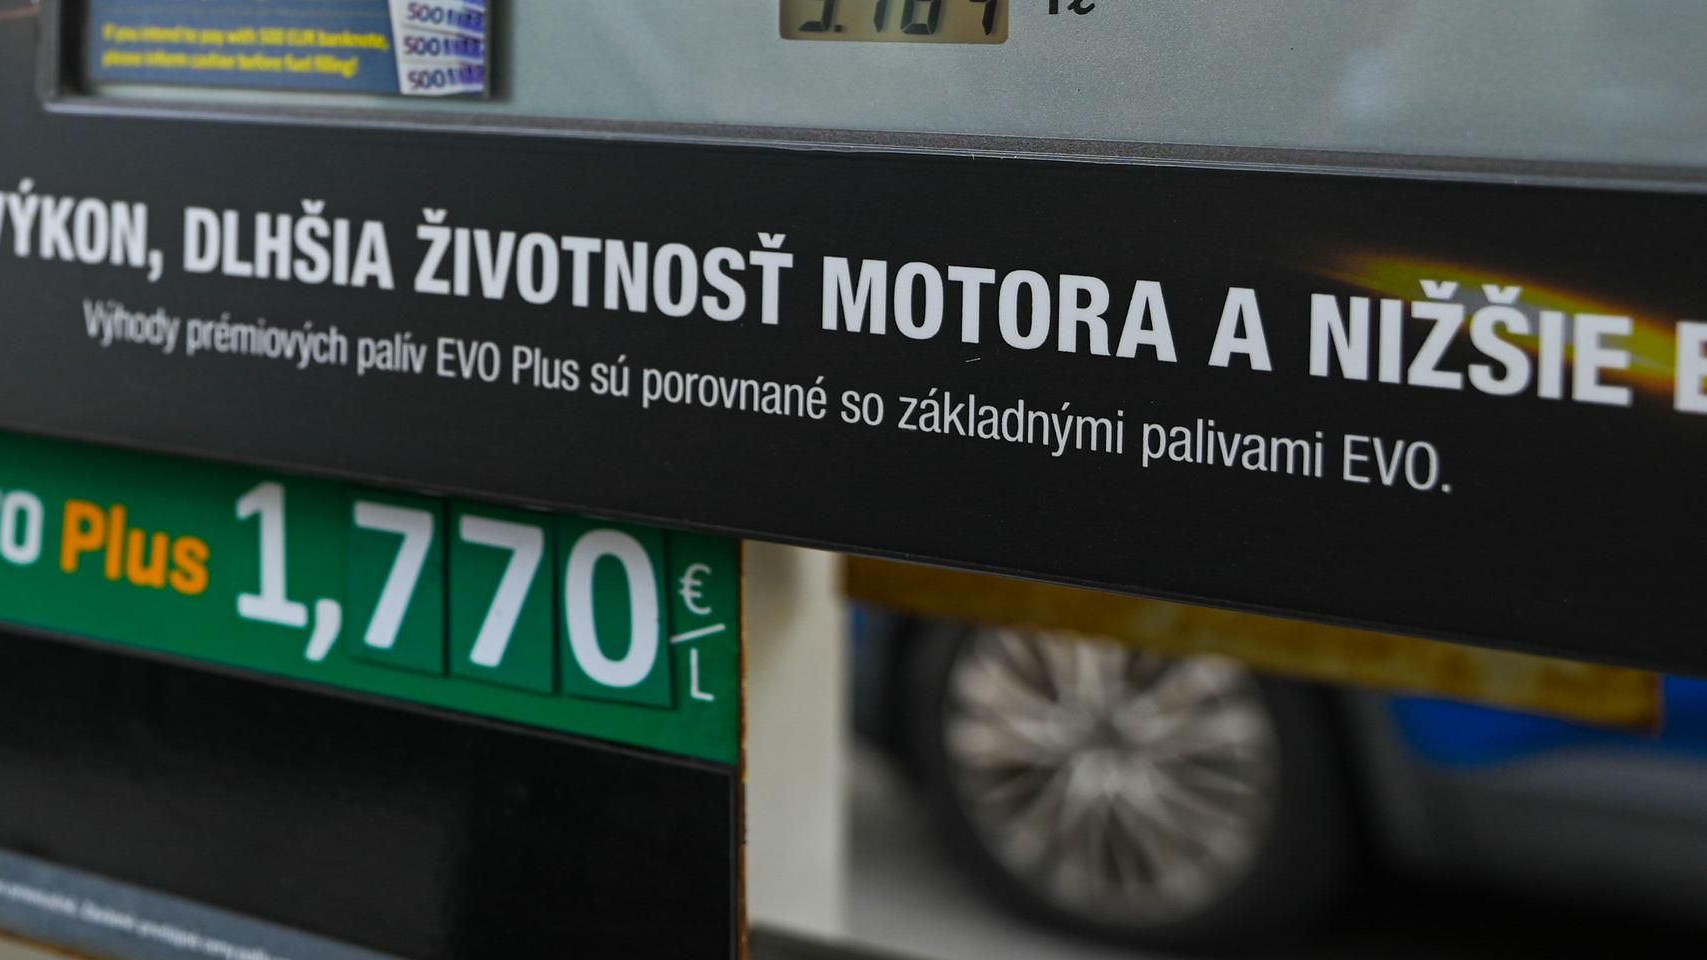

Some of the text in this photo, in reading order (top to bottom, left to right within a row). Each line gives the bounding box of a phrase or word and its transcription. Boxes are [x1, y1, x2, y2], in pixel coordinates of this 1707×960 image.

[403, 35, 441, 56] 500
[406, 1, 444, 25] 500
[407, 68, 446, 89] 500
[183, 198, 395, 291] DLHŠIA
[414, 208, 794, 327] ŽIVOTNOSŤ
[821, 255, 1178, 364] MOTORA
[1207, 286, 1273, 373] A
[1309, 279, 1633, 409] NIŽŠIE
[83, 298, 1453, 494] Výhody prémiových palív EVO Plus sú porovnané so základnými palivami EVO.
[59, 499, 210, 596] Plus
[233, 480, 662, 690] 1,770
